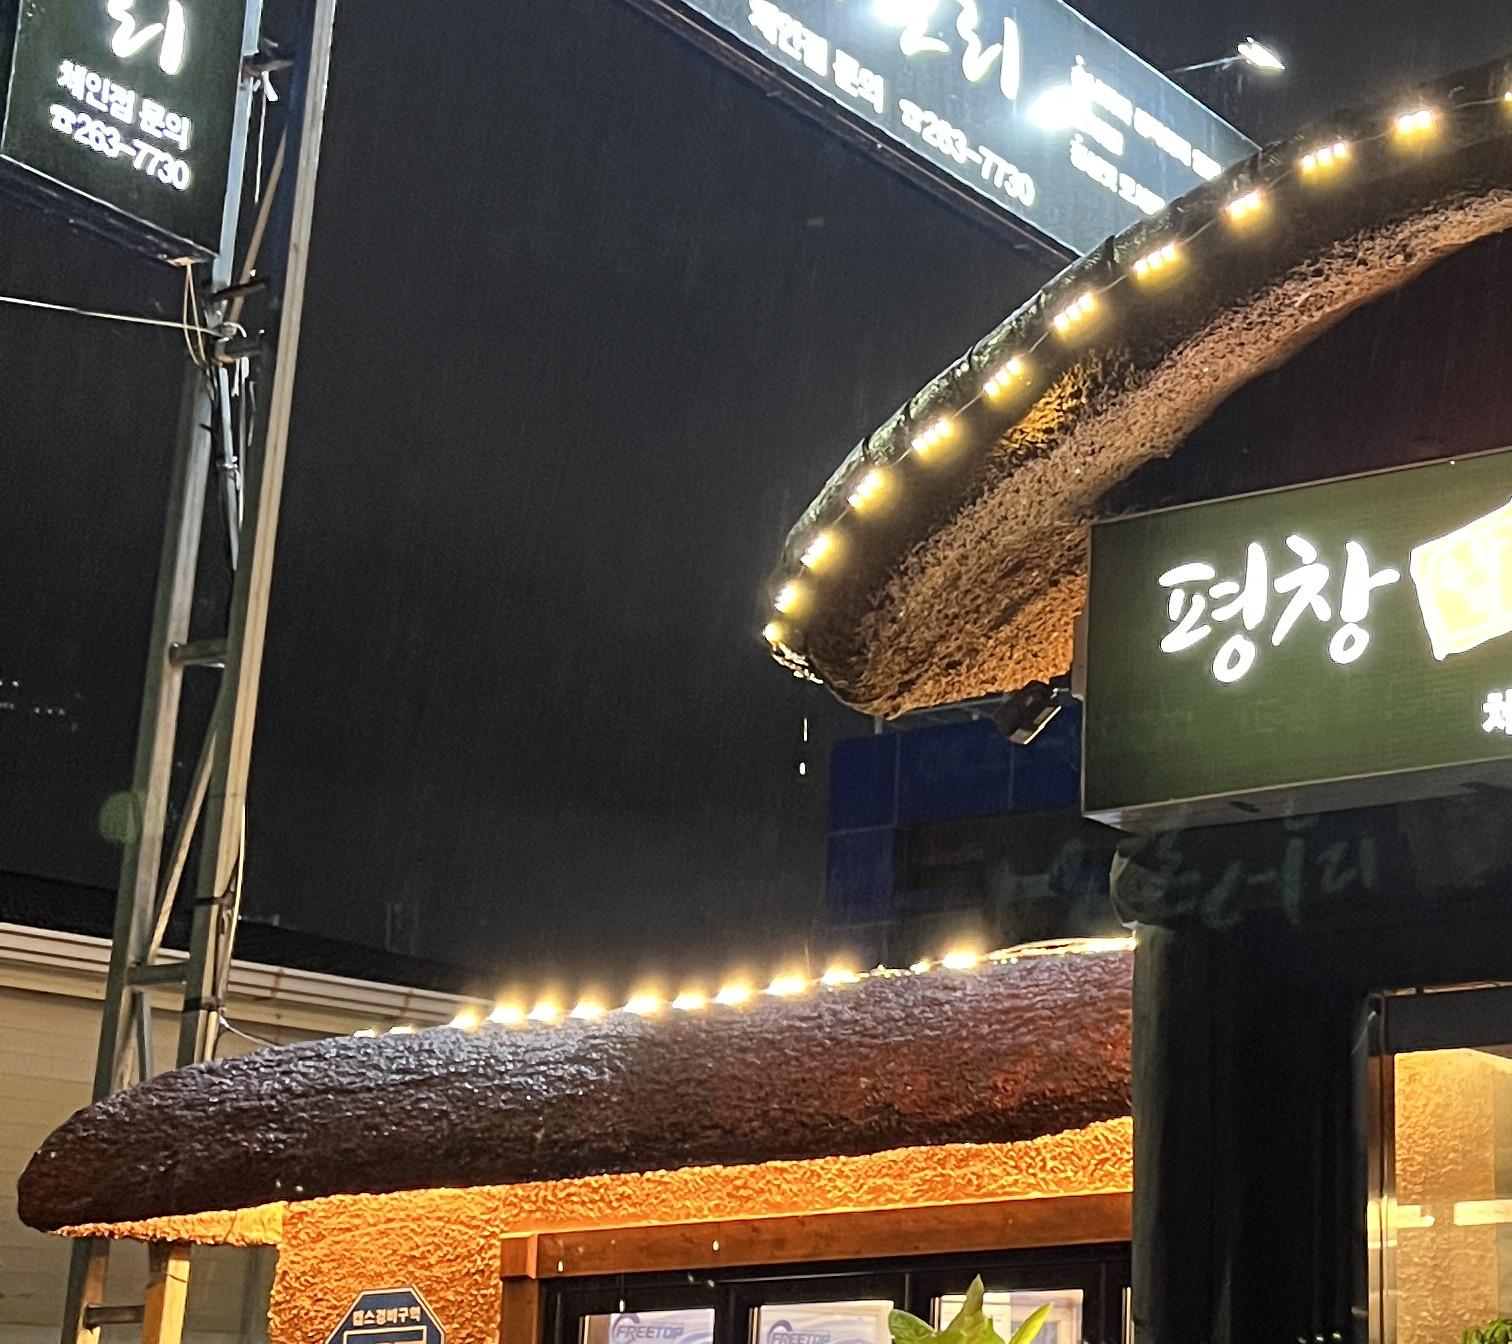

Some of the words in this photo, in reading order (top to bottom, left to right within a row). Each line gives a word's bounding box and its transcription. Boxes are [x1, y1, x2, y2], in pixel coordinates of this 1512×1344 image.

[57, 59, 135, 124] 체인점
[139, 98, 192, 151] 문의
[74, 113, 192, 191] 263-7730
[1159, 535, 1400, 683] 평창
